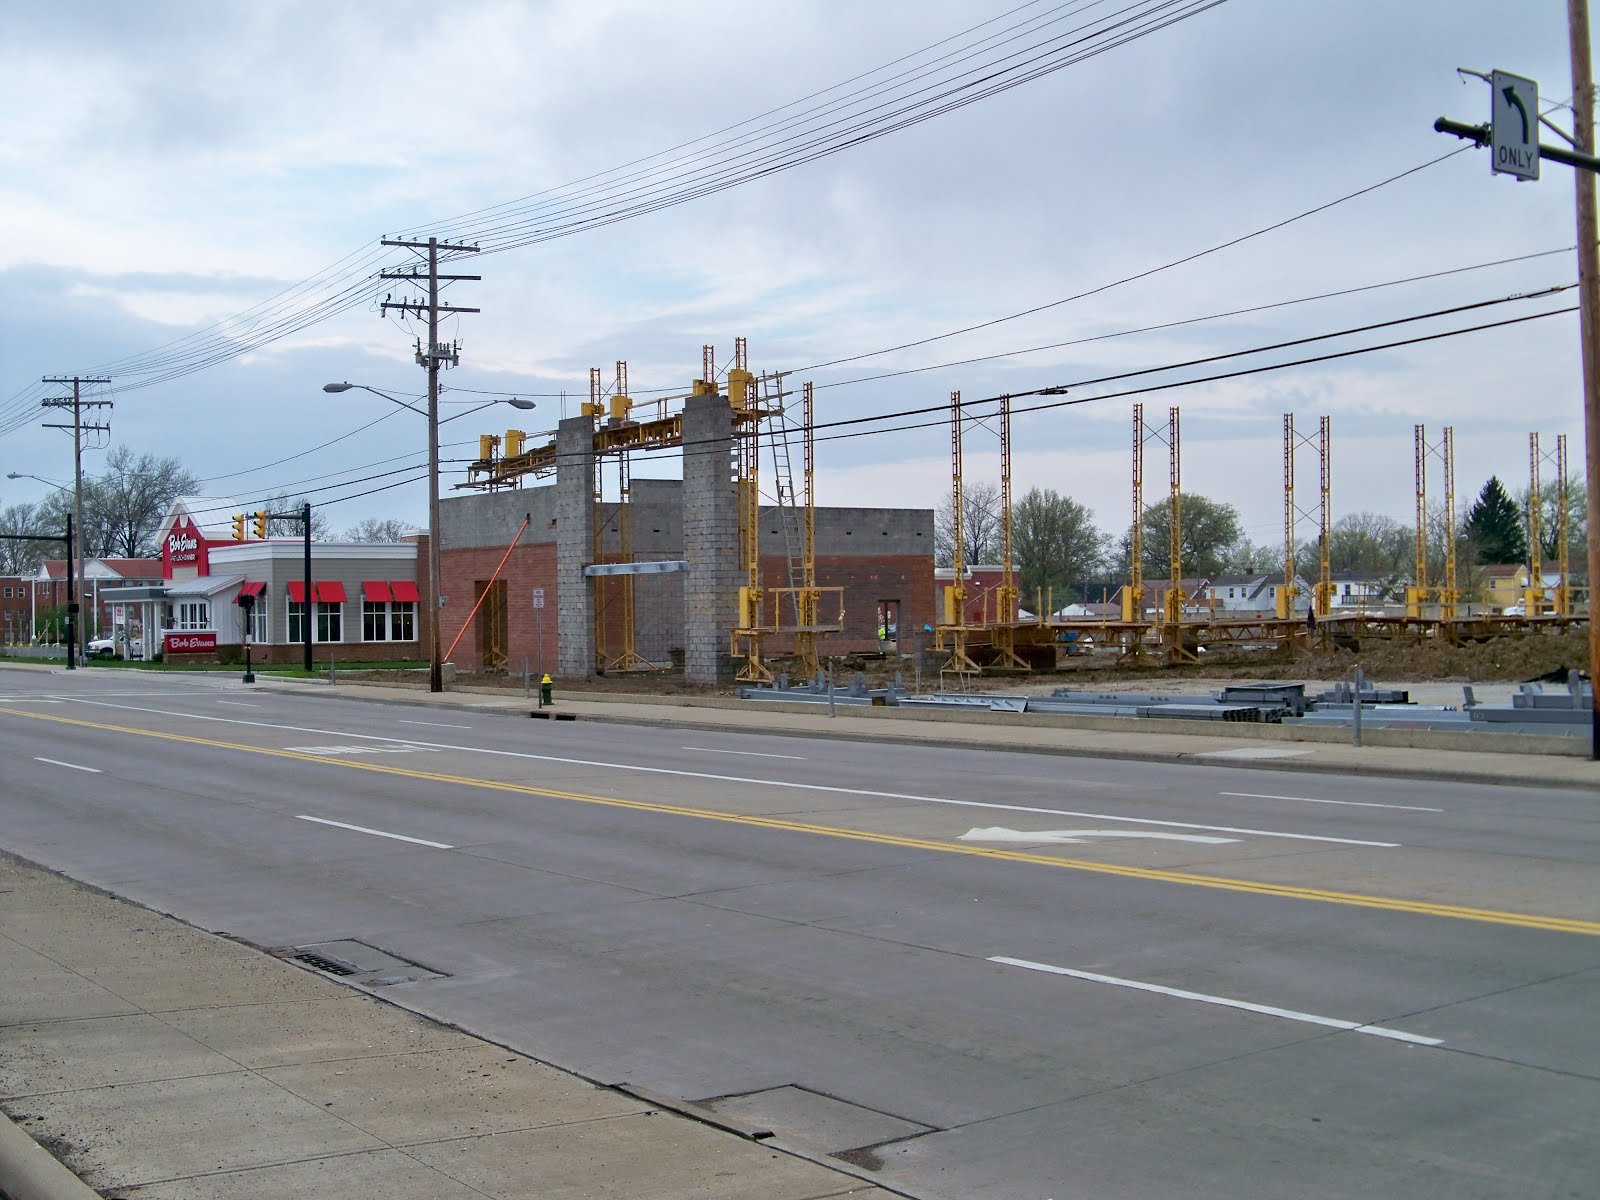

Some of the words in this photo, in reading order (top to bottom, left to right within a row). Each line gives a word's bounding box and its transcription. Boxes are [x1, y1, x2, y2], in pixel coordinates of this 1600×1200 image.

[1499, 145, 1533, 169] ONLY
[168, 534, 180, 553] Bob
[169, 637, 189, 648] Bob
[189, 637, 215, 648] Evans
